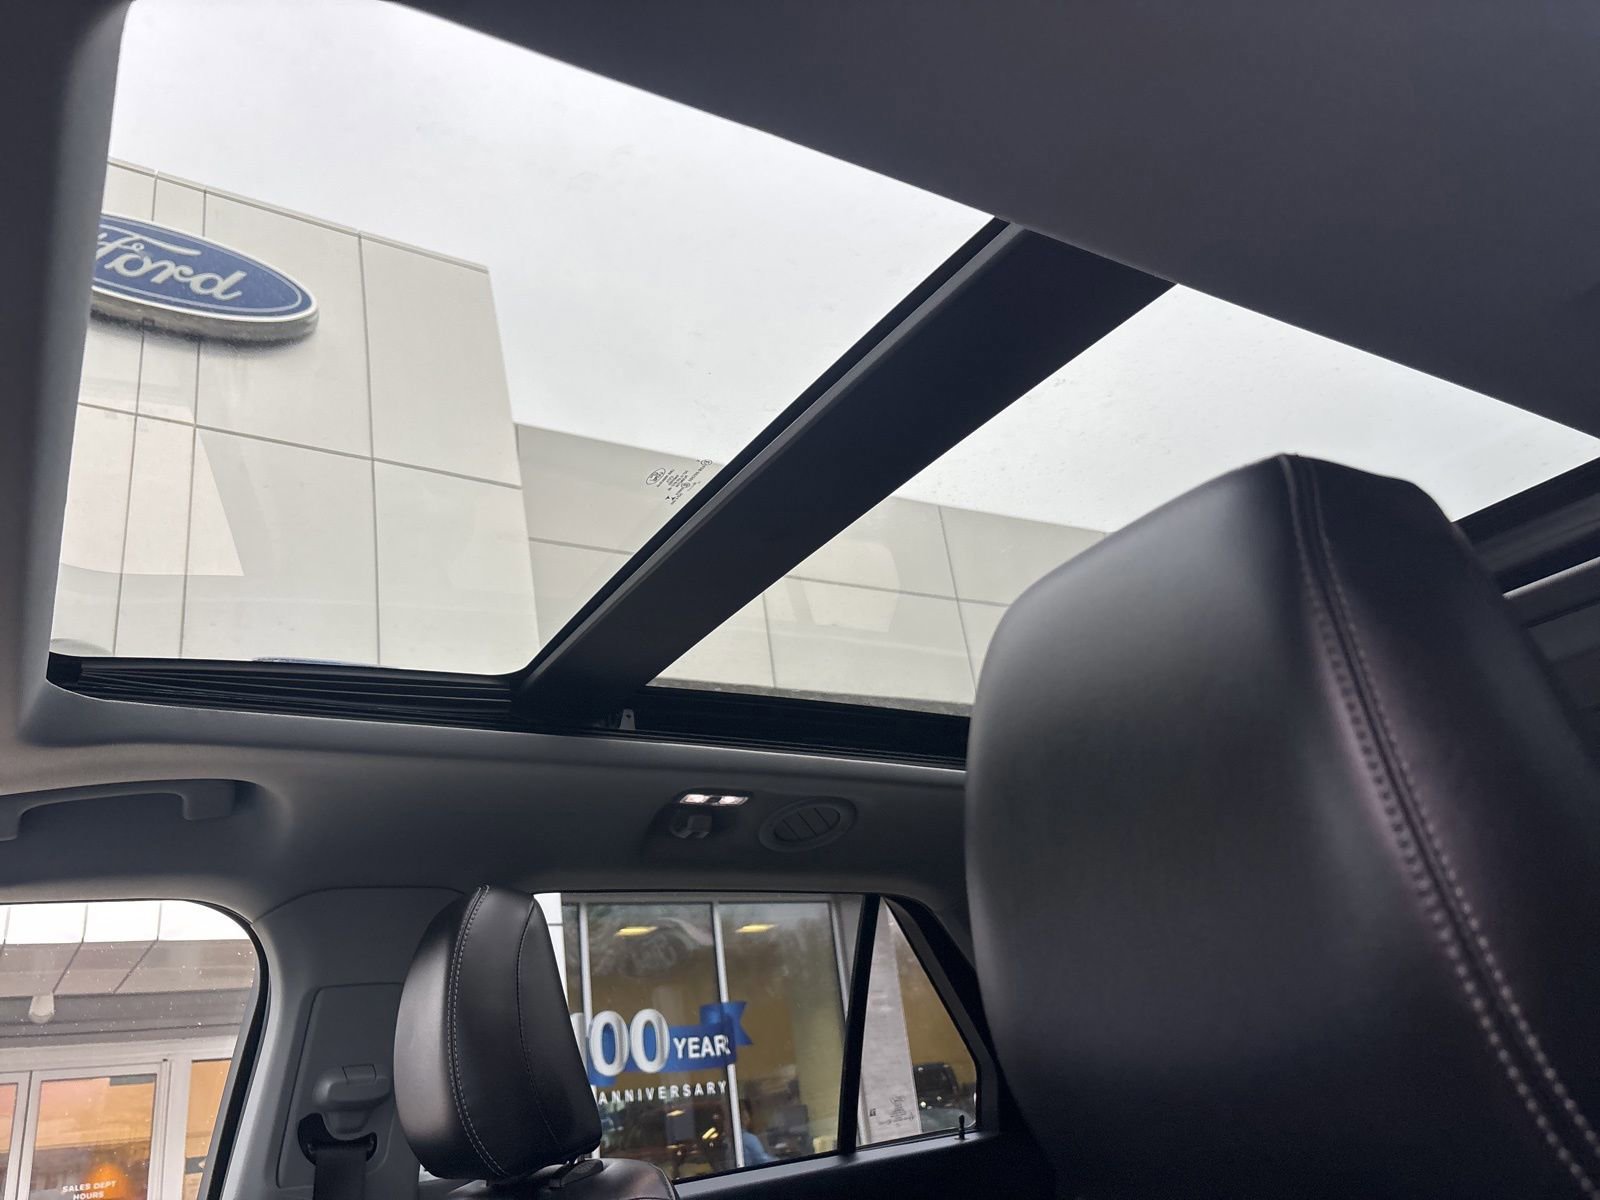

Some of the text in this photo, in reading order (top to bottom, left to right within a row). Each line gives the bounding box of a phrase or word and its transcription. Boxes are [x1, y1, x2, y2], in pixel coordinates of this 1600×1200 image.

[97, 224, 247, 301] Ford
[673, 1034, 731, 1060] YEAR
[597, 1080, 727, 1104] ANNIVERSARY
[62, 1180, 117, 1193] SALES DEPT
[72, 1191, 104, 1200] HOURS
